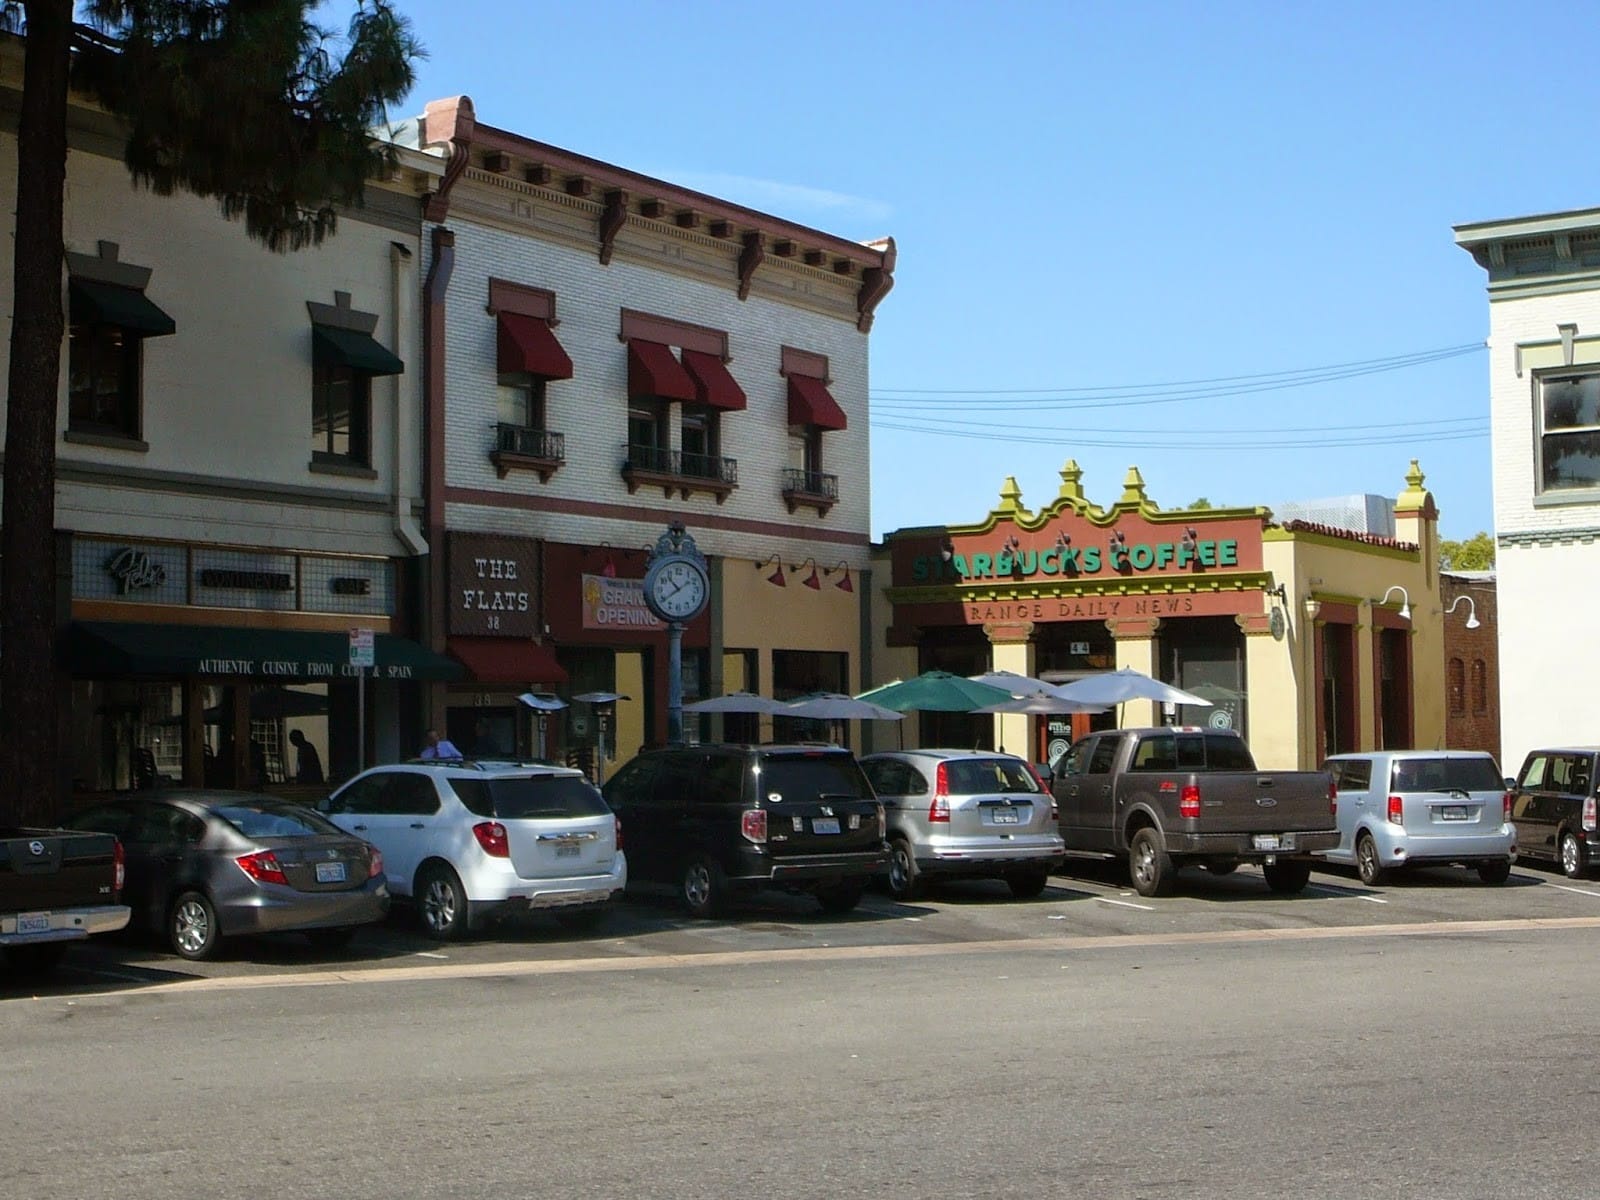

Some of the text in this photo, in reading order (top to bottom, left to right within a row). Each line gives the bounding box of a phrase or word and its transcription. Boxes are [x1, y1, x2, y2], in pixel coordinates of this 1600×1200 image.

[474, 558, 517, 579] THE
[912, 539, 1237, 581] STARBUCKS COFFEE
[463, 590, 529, 612] FLATS
[603, 590, 648, 607] GRAN
[597, 608, 660, 627] OPENING
[970, 598, 1193, 620] RANGE DAILY NEWS
[487, 616, 501, 630] 38
[1071, 643, 1089, 654] 44
[198, 659, 413, 679] AUTHENTIC CUISINE FROM CUB & SPAIN
[474, 693, 492, 706] 38
